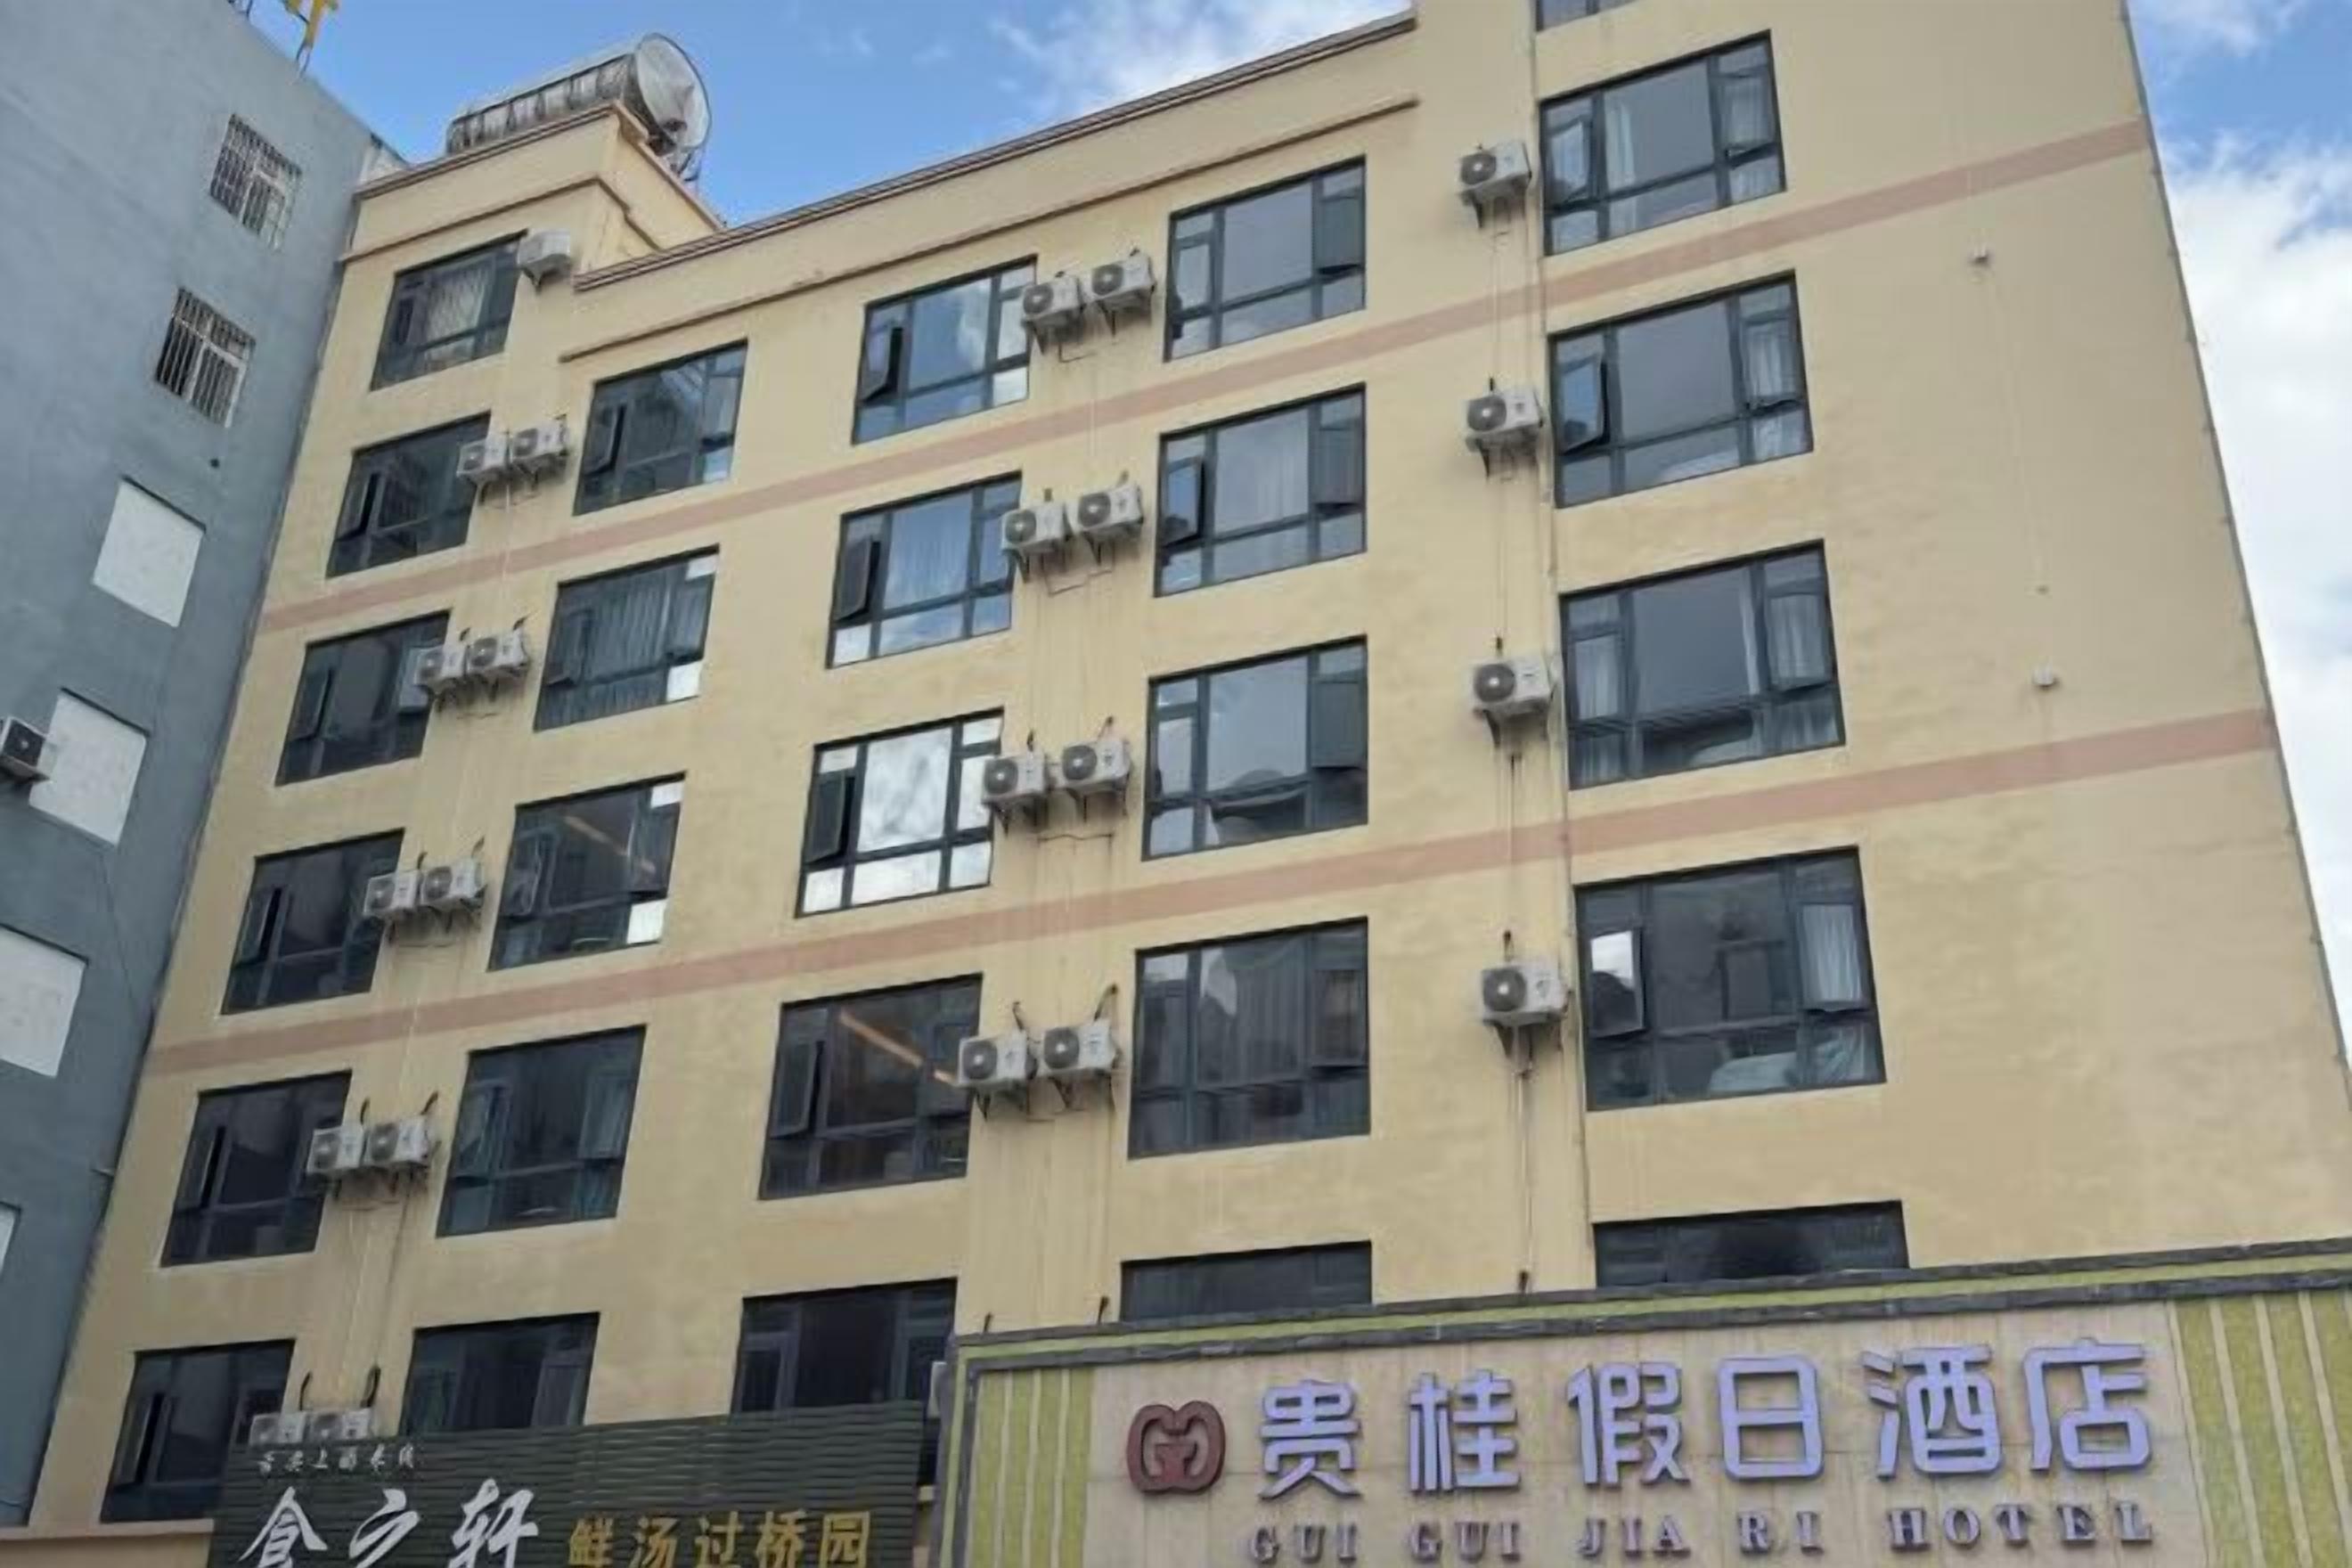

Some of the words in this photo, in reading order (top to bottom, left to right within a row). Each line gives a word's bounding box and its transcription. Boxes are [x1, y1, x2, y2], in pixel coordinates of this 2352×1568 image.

[1258, 1336, 2152, 1500] 贵桂假日酒店
[567, 1508, 871, 1568] 鲜汤过桥园
[1253, 1519, 1359, 1564] GUI
[1409, 1518, 1521, 1562] GUI
[1580, 1514, 1691, 1557] JIA
[1737, 1507, 1825, 1555] RI
[1888, 1500, 2153, 1553] HOTEL
